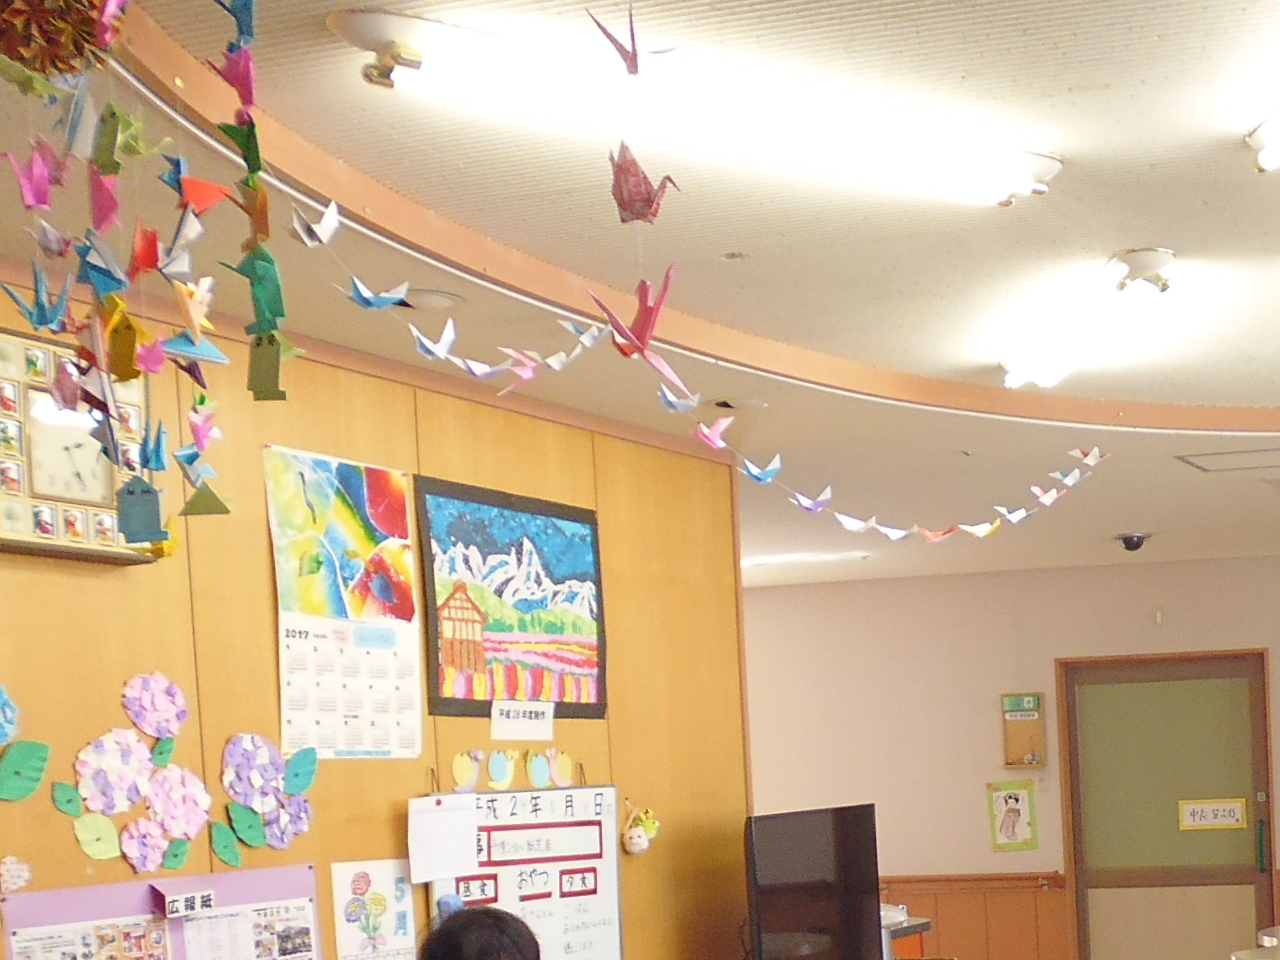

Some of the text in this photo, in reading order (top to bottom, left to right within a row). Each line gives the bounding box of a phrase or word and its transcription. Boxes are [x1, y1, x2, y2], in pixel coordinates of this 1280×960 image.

[284, 628, 310, 640] 2017
[517, 869, 550, 890] おやつ
[566, 874, 589, 889] 夕食
[167, 893, 213, 915] 広報紙
